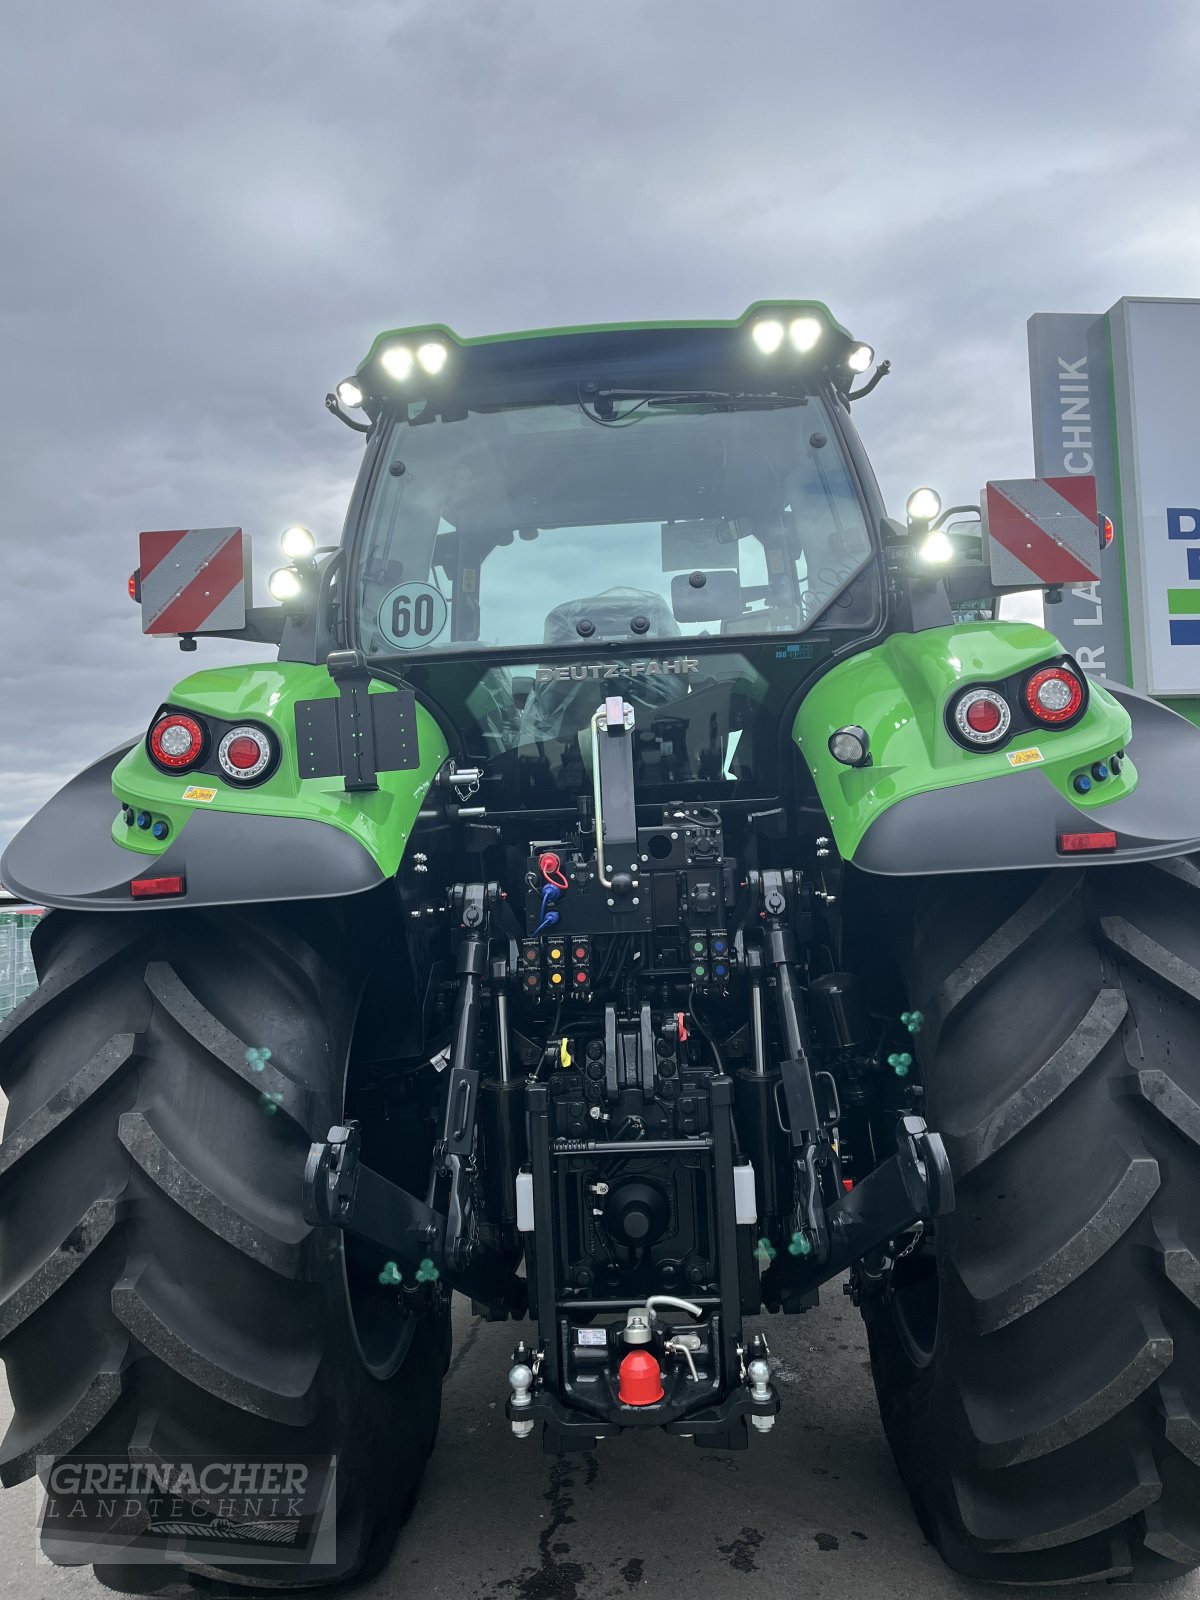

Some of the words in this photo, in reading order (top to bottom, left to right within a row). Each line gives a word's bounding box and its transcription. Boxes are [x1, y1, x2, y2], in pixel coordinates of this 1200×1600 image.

[1058, 356, 1102, 626] LACHNIK
[392, 594, 434, 637] 60
[536, 659, 699, 682] DEUTZ-FAHR
